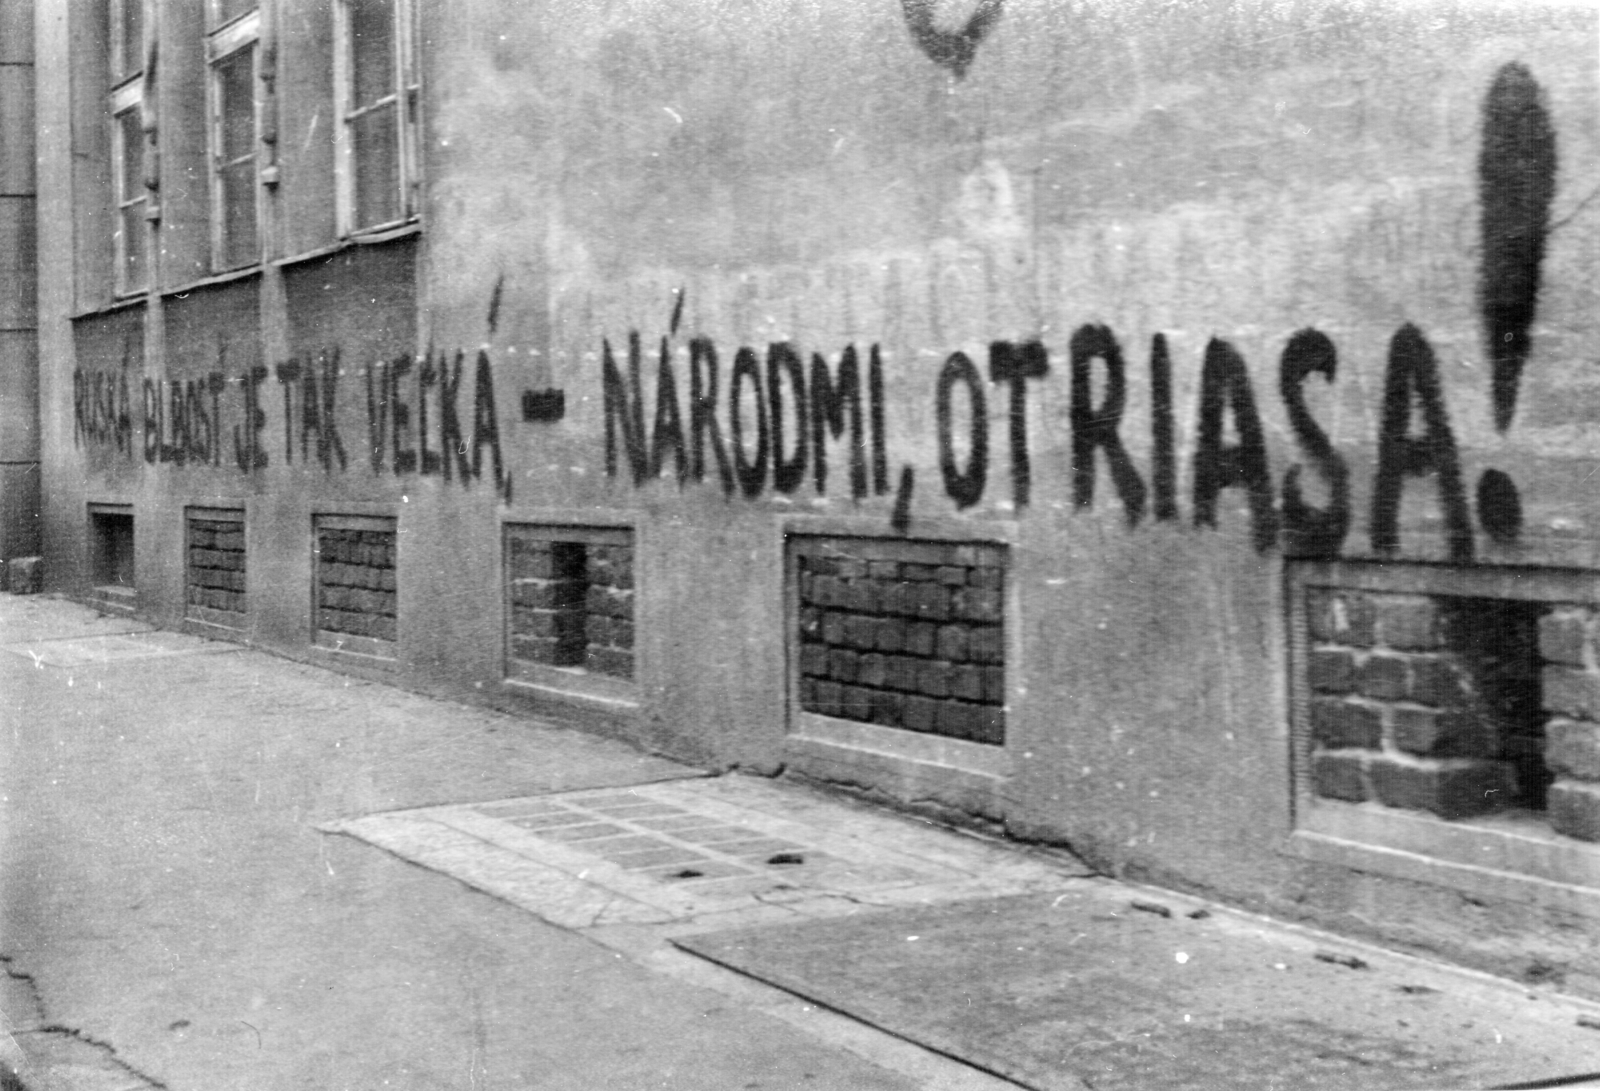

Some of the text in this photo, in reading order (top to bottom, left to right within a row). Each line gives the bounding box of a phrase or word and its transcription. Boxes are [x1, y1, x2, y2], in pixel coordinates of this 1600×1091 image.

[233, 365, 268, 474] JE
[276, 346, 347, 475] TAK
[936, 61, 1555, 562] OTRIASA!
